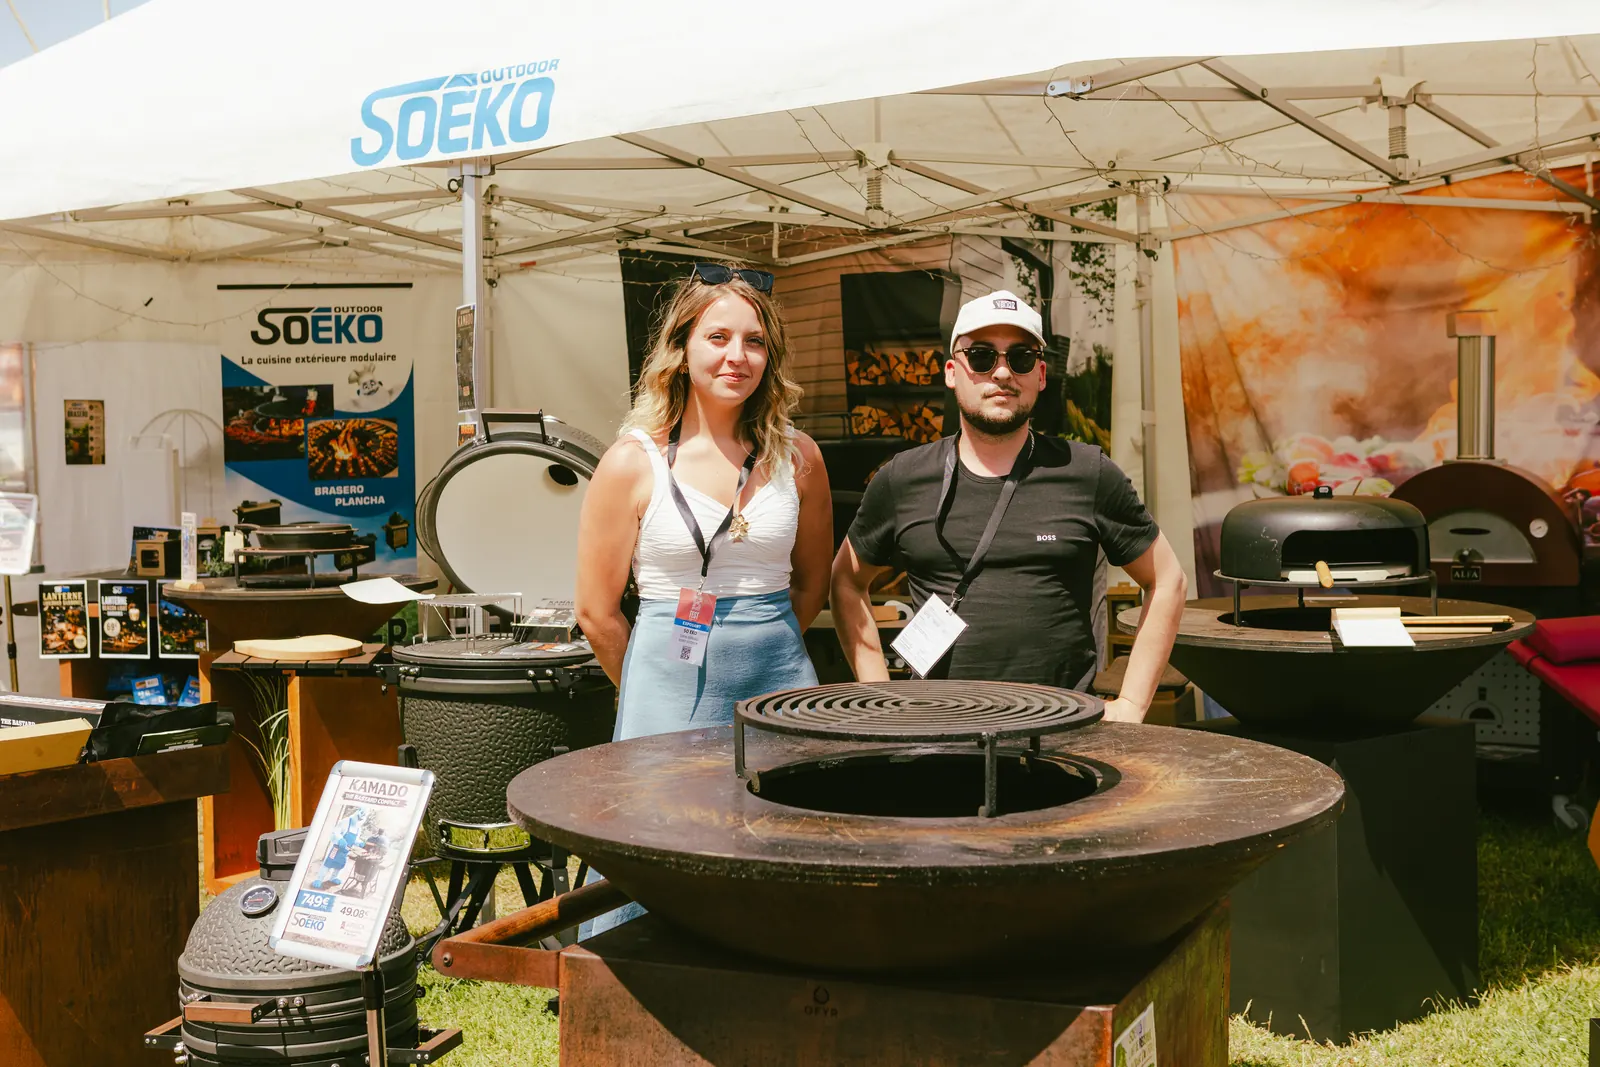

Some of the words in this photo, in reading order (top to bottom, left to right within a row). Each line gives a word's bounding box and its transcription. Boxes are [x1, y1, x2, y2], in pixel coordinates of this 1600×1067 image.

[480, 58, 560, 84] OUTDOOR
[333, 305, 383, 313] OUTDOOR
[241, 355, 253, 365] La
[256, 354, 291, 365] cuisine
[295, 353, 347, 364] extérieure
[350, 352, 397, 362] modulaire
[314, 485, 364, 496] BRASERO
[335, 496, 386, 507] PLANCHA
[1036, 534, 1057, 542] BOSS
[42, 592, 83, 601] LANTERNE
[682, 620, 702, 629] EXPOSANT
[12, 719, 36, 727] BASTARD
[349, 779, 408, 797] KAMADO
[354, 794, 378, 804] BASTARD
[377, 798, 401, 806] COMPACT
[300, 893, 330, 907] 749€
